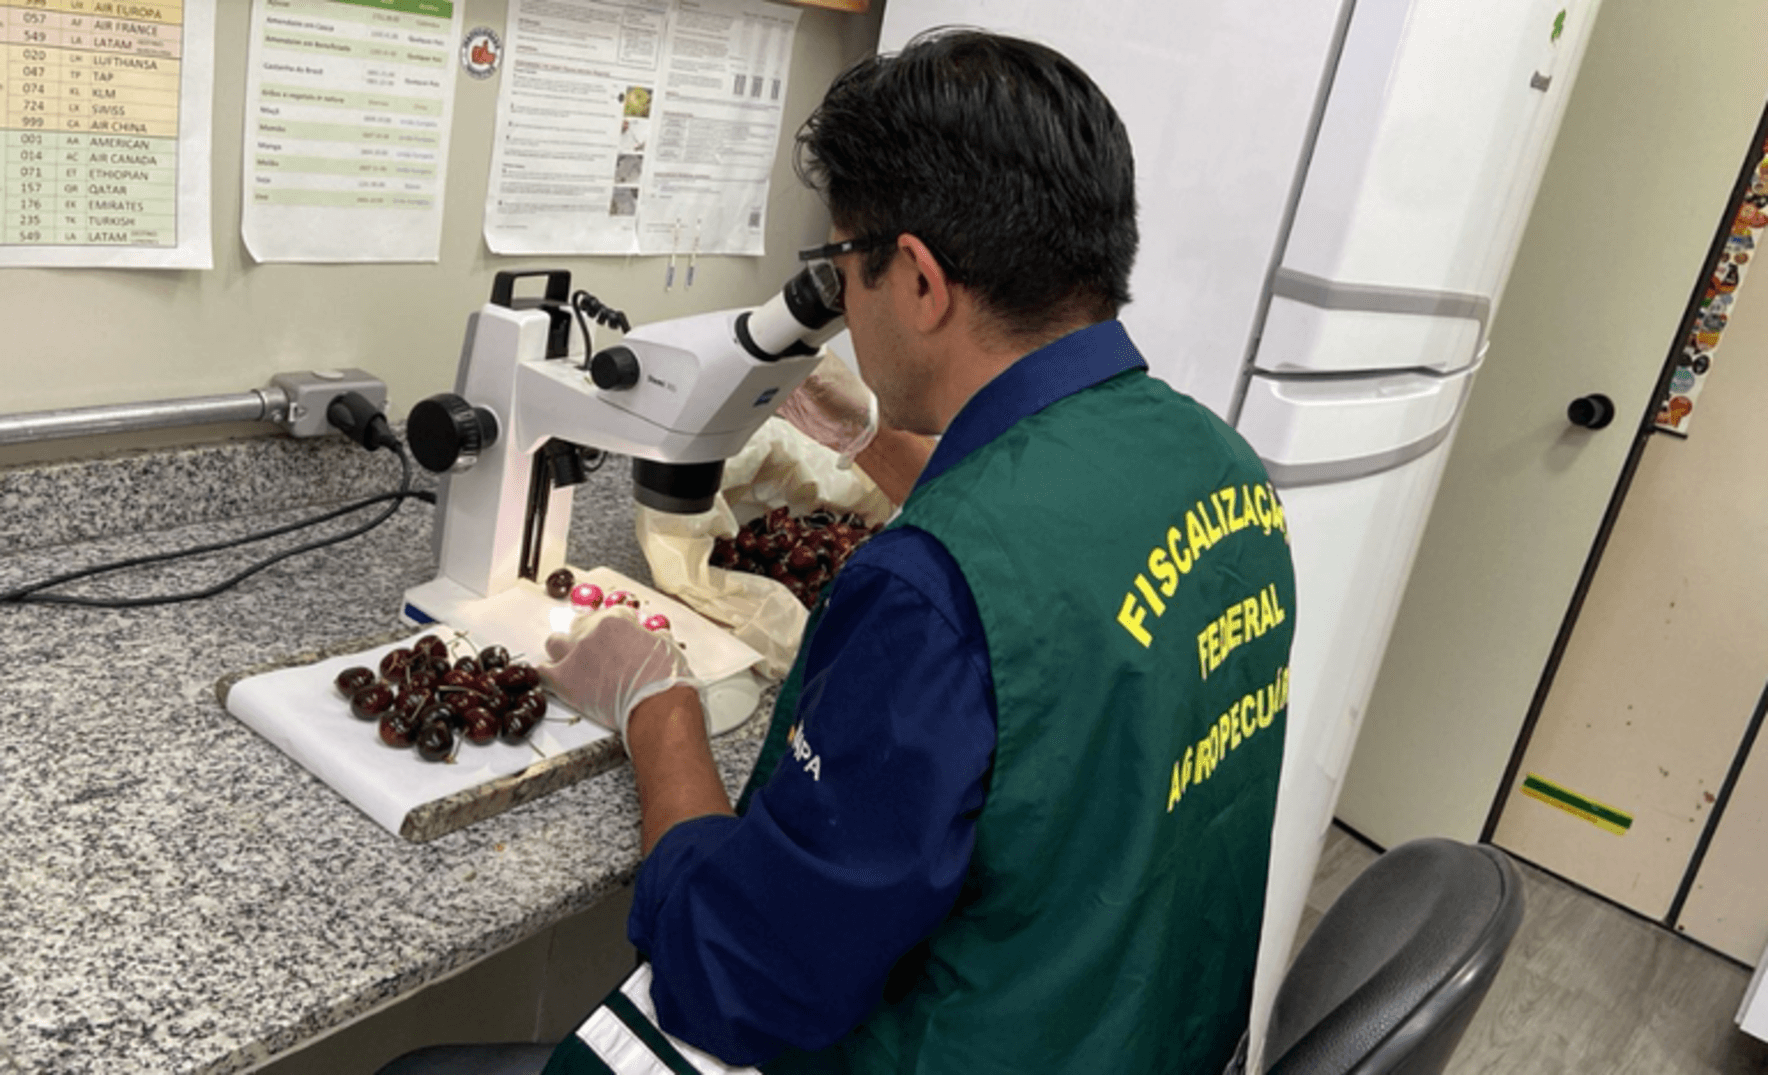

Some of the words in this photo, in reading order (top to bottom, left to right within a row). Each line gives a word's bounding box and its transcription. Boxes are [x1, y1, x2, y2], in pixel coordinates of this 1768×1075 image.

[95, 2, 113, 12] AIR
[116, 5, 162, 19] EUROPA
[23, 12, 46, 23] 057
[94, 20, 112, 31] AIR
[115, 23, 157, 37] FRANCE
[24, 30, 46, 42] 549
[94, 37, 132, 49] LATAM
[94, 56, 158, 70] LUFTHANSA
[93, 71, 114, 81] TAP
[22, 83, 44, 94] 074
[92, 89, 116, 99] KLM
[92, 104, 125, 116] SWISS
[22, 116, 44, 127] 999
[91, 120, 109, 130] AIR
[111, 121, 147, 134] CHINA
[21, 134, 42, 145] 001
[89, 137, 150, 150] AMERICAN
[20, 150, 42, 161] 014
[89, 153, 108, 163] AIR
[110, 154, 157, 166] CANADA
[20, 166, 41, 177] 071
[89, 168, 149, 180] ETHIOPIAN
[21, 182, 42, 193] 157
[88, 184, 127, 195] QATAR
[21, 199, 41, 210] 176
[88, 200, 143, 212] EMIRATES
[20, 214, 41, 226] 235
[89, 216, 135, 227] TURKISH
[19, 230, 41, 241] 549
[88, 232, 127, 242] LATAM
[1116, 481, 1287, 648] FISCALIZAÇÃ
